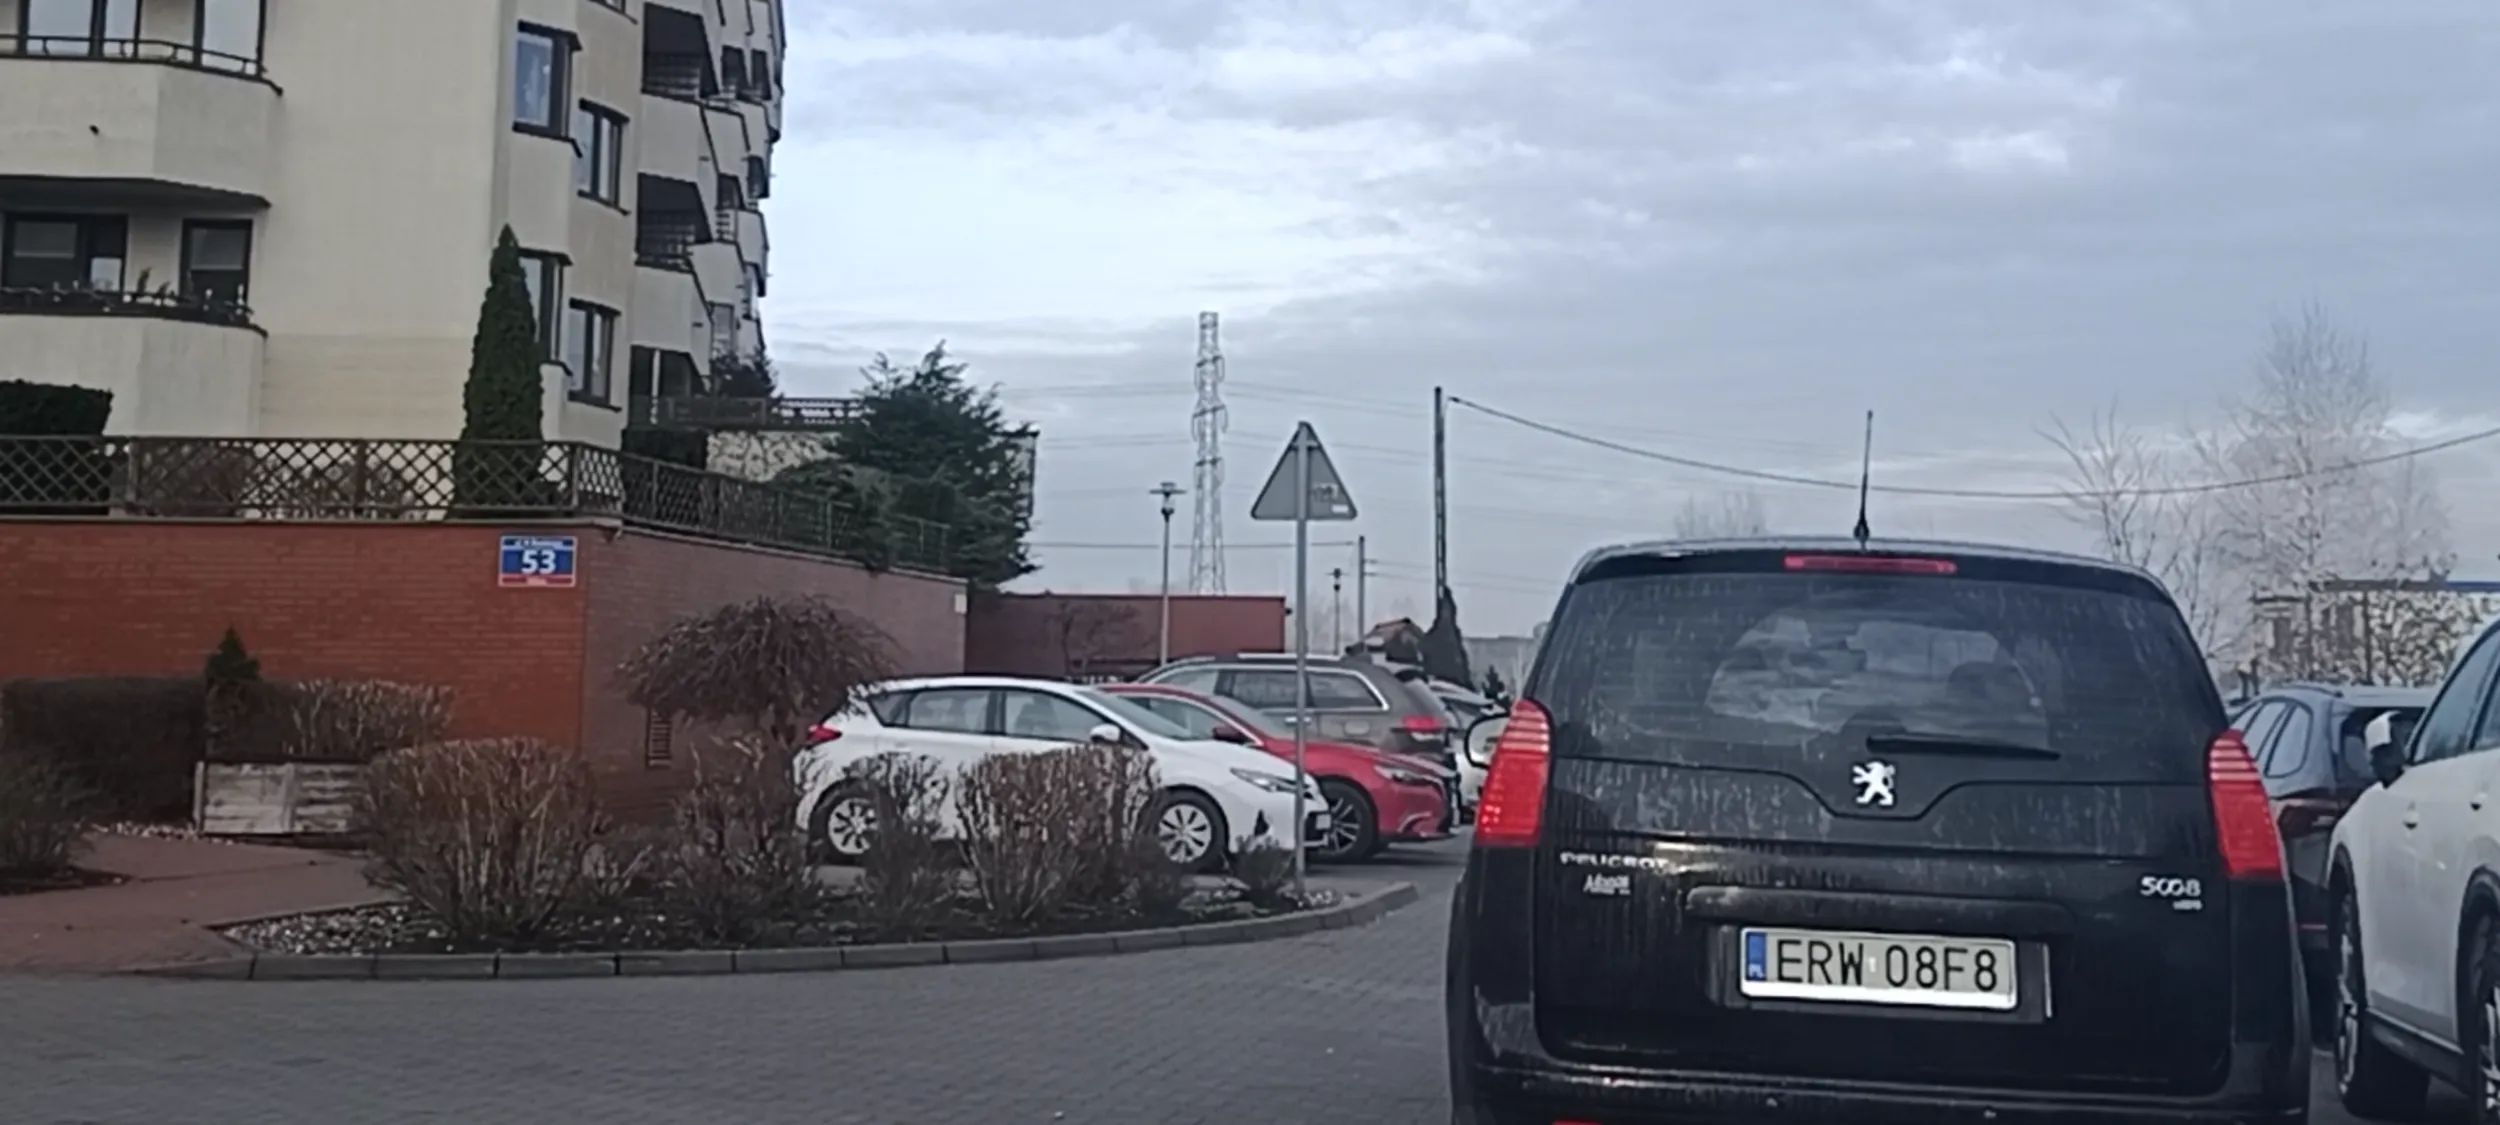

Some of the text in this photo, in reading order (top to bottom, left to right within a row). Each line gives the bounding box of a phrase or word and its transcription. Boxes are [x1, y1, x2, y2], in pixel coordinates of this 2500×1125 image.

[520, 549, 557, 574] 53
[1560, 852, 1669, 869] PEUGEOT
[2140, 876, 2202, 897] 5008
[1777, 939, 1998, 993] ERW 08F8
